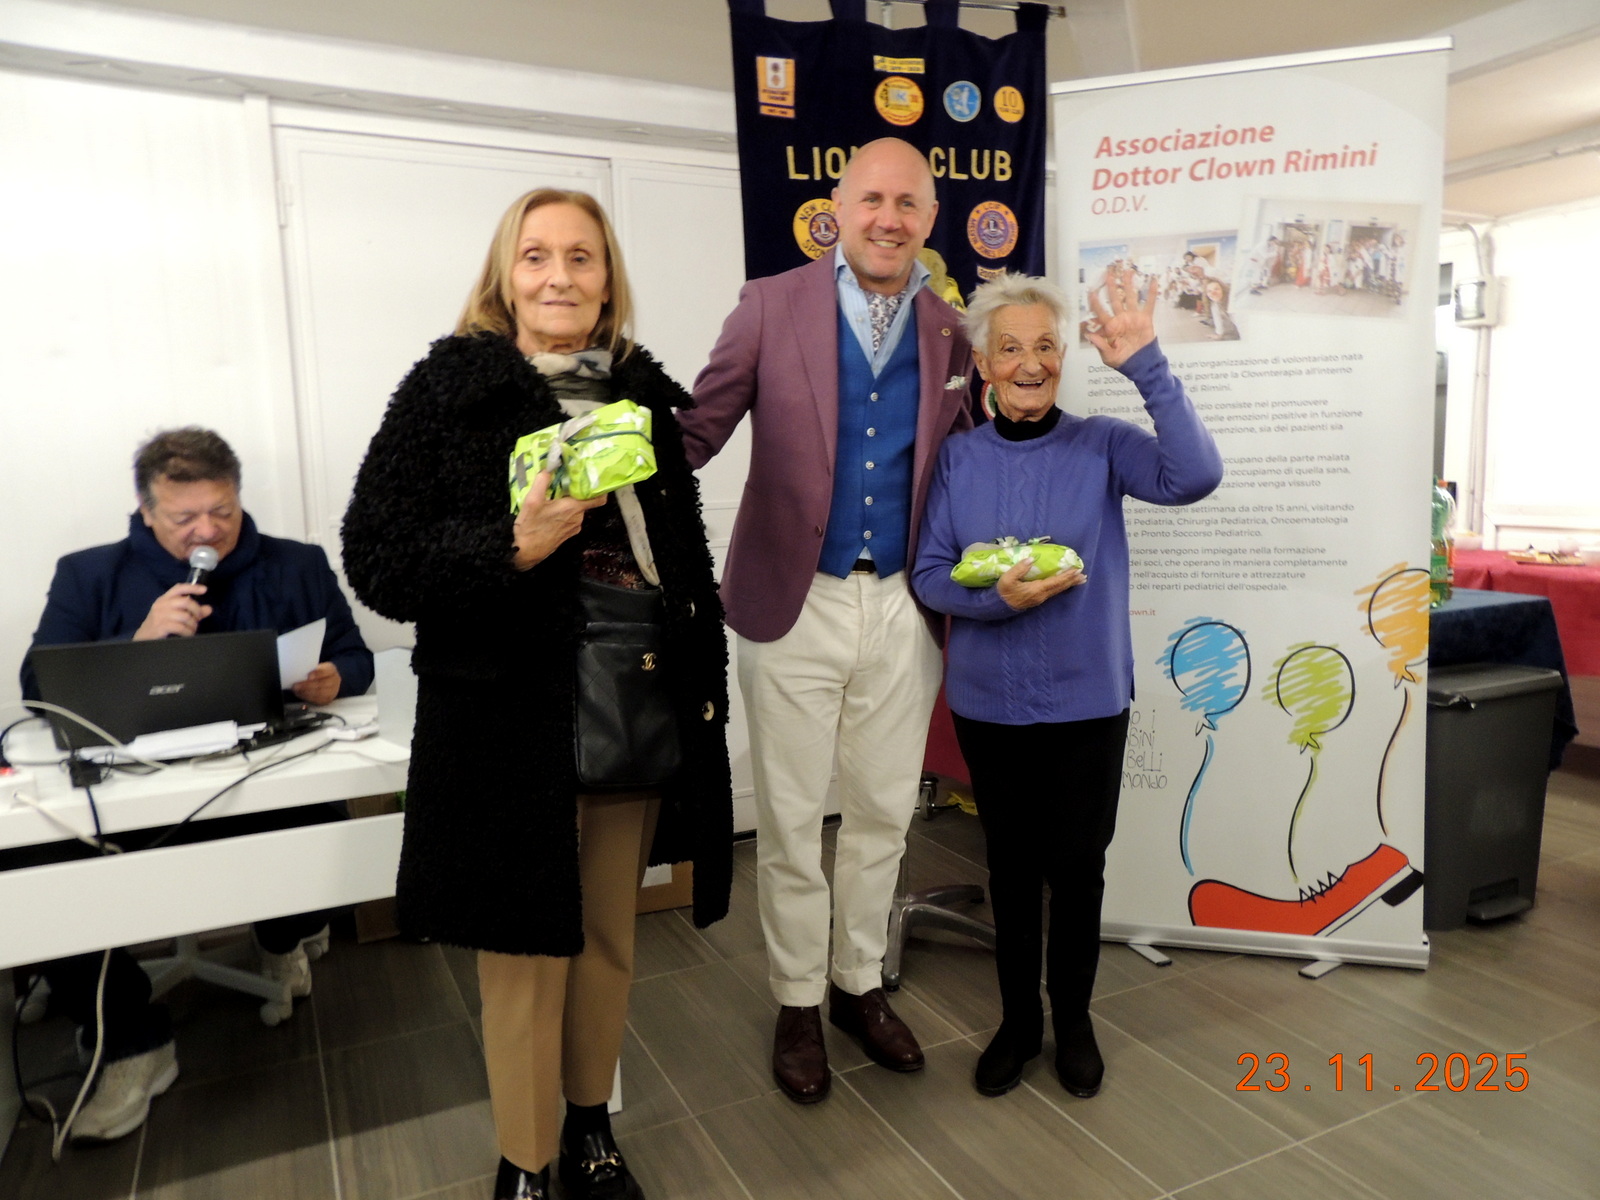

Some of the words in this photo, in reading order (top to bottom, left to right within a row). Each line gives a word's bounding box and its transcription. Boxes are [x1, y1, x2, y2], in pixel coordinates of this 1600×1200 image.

[1094, 124, 1275, 159] Associazione
[786, 146, 859, 181] LIO
[929, 146, 1012, 181] CLUB
[1091, 165, 1182, 191] Dottor
[1188, 156, 1275, 183] Clown
[1283, 142, 1378, 173] Rimini
[1091, 194, 1148, 215] O.D.V.
[799, 205, 816, 223] NEW
[1187, 358, 1269, 371] un'organizzazione
[1271, 356, 1280, 364] di
[1282, 355, 1339, 364] volontariato
[1341, 353, 1363, 361] nata
[1088, 377, 1101, 385] nel
[1104, 376, 1125, 385] 2006
[1195, 372, 1229, 383] portare
[1231, 371, 1239, 379] la
[1241, 368, 1303, 380] Clownterapia
[1305, 366, 1352, 376] all'interno
[1087, 387, 1139, 398] dell'Ospeda
[1189, 385, 1198, 393] di
[1201, 383, 1232, 393] Rimini.
[1215, 401, 1251, 410] consiste
[1254, 400, 1269, 408] nel
[1271, 399, 1328, 409] promuovere
[1202, 414, 1224, 422] delle
[1227, 412, 1269, 421] emozioni
[1271, 411, 1308, 421] positive
[1310, 410, 1319, 418] in
[1321, 409, 1363, 418] funzione
[1259, 425, 1272, 433] sia
[1274, 424, 1288, 432] dei
[1291, 423, 1328, 434] pazienti
[1330, 422, 1343, 431] sia
[1265, 454, 1287, 462] della
[1290, 454, 1315, 464] parte
[1317, 453, 1350, 461] malata
[1231, 467, 1282, 477] occupiamo
[1284, 466, 1293, 474] di
[1295, 466, 1324, 476] quella
[1326, 467, 1351, 475] sana,
[1258, 480, 1286, 489] venga
[1288, 478, 1321, 487] vissuto
[1134, 505, 1167, 513] servizio
[1169, 505, 1188, 515] ogni
[1191, 504, 1236, 513] settimana
[1238, 504, 1250, 512] da
[1252, 504, 1273, 512] oltre
[1275, 504, 1284, 512] 15
[1286, 503, 1309, 513] anni,
[1311, 503, 1354, 512] visitando
[1134, 517, 1175, 526] Pediatria,
[1177, 517, 1218, 527] Chirurgia
[1220, 517, 1269, 526] Pediatrica,
[1271, 516, 1348, 526] Oncoematologia
[1141, 530, 1171, 538] Pronto
[1173, 529, 1213, 538] Soccorso
[1215, 528, 1263, 537] Pediatrico.
[1160, 548, 1199, 557] vengono
[1201, 547, 1247, 557] impiegate
[1249, 546, 1271, 554] nella
[1273, 546, 1326, 554] formazione
[1143, 559, 1163, 568] soci,
[1165, 558, 1181, 566] che
[1183, 560, 1221, 569] operano
[1222, 558, 1231, 566] in
[1233, 558, 1271, 566] maniera
[1273, 558, 1348, 569] completamente
[1134, 570, 1188, 581] nell'acquisto
[1190, 570, 1199, 579] di
[1201, 570, 1240, 579] forniture
[1250, 571, 1306, 579] attrezzature
[1136, 582, 1149, 590] dei
[1152, 582, 1181, 592] reparti
[1183, 582, 1225, 592] pediatrici
[1227, 582, 1289, 592] dell'ospedale.
